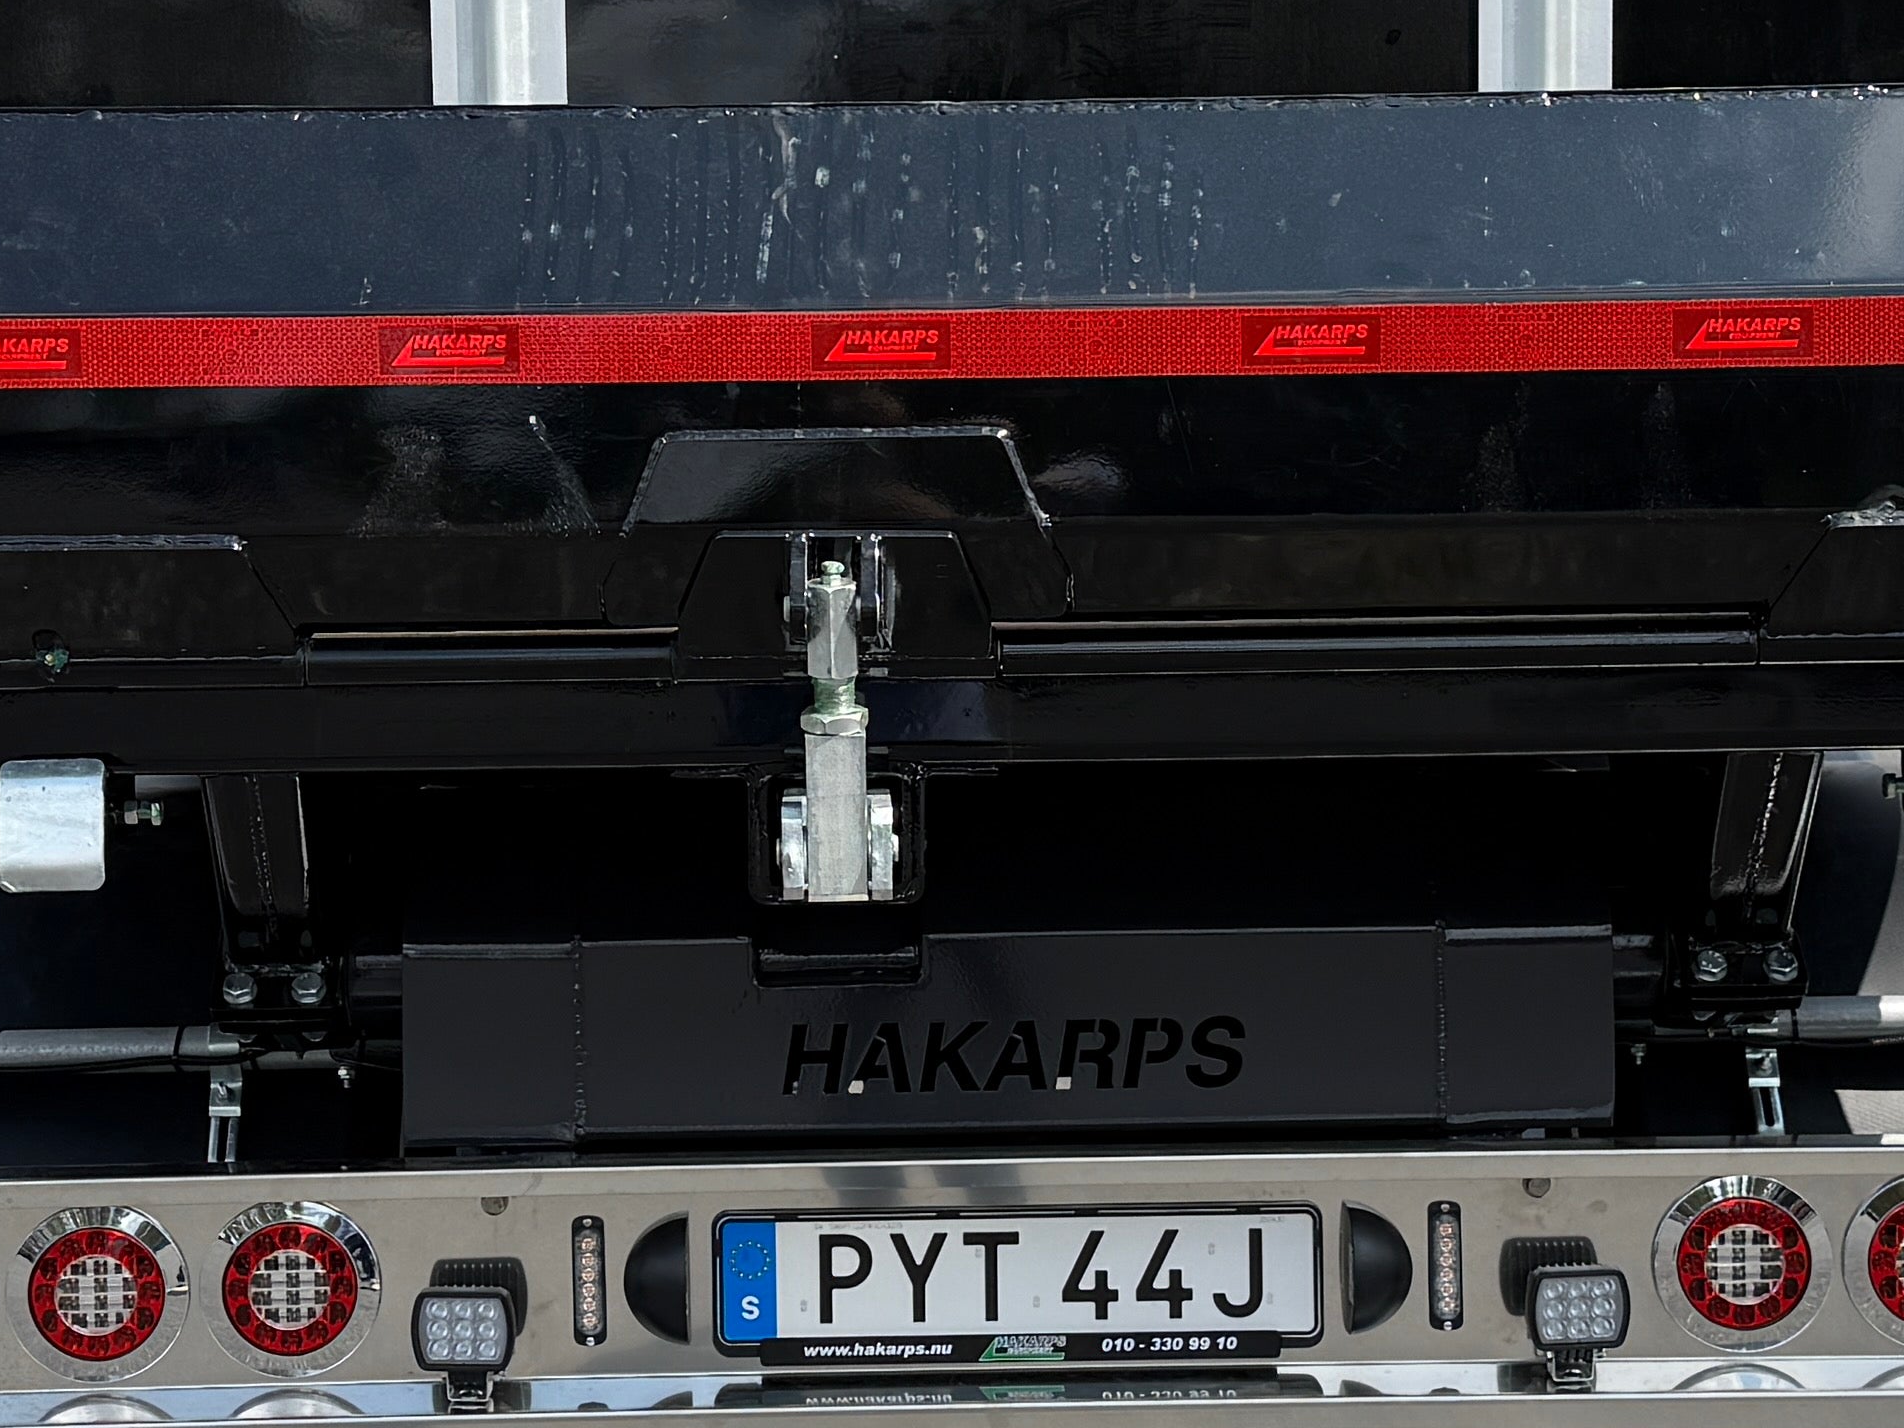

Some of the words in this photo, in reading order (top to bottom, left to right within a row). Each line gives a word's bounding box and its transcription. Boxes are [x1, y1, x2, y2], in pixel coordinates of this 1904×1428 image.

[1276, 324, 1368, 339] HAKARPS
[1708, 317, 1801, 332] HAKARPS
[413, 335, 506, 350] HAKARPS
[846, 330, 939, 345] HAKARPS
[782, 1015, 1246, 1095] HAKARPS
[819, 1231, 1020, 1324] PYT
[1062, 1228, 1263, 1320] 44J
[741, 1295, 760, 1320] S
[804, 1342, 953, 1358] www.hakarps.nu
[1101, 1338, 1135, 1352] 010
[1150, 1337, 1184, 1351] 330
[1188, 1337, 1210, 1351] 99
[1216, 1336, 1237, 1350] 10
